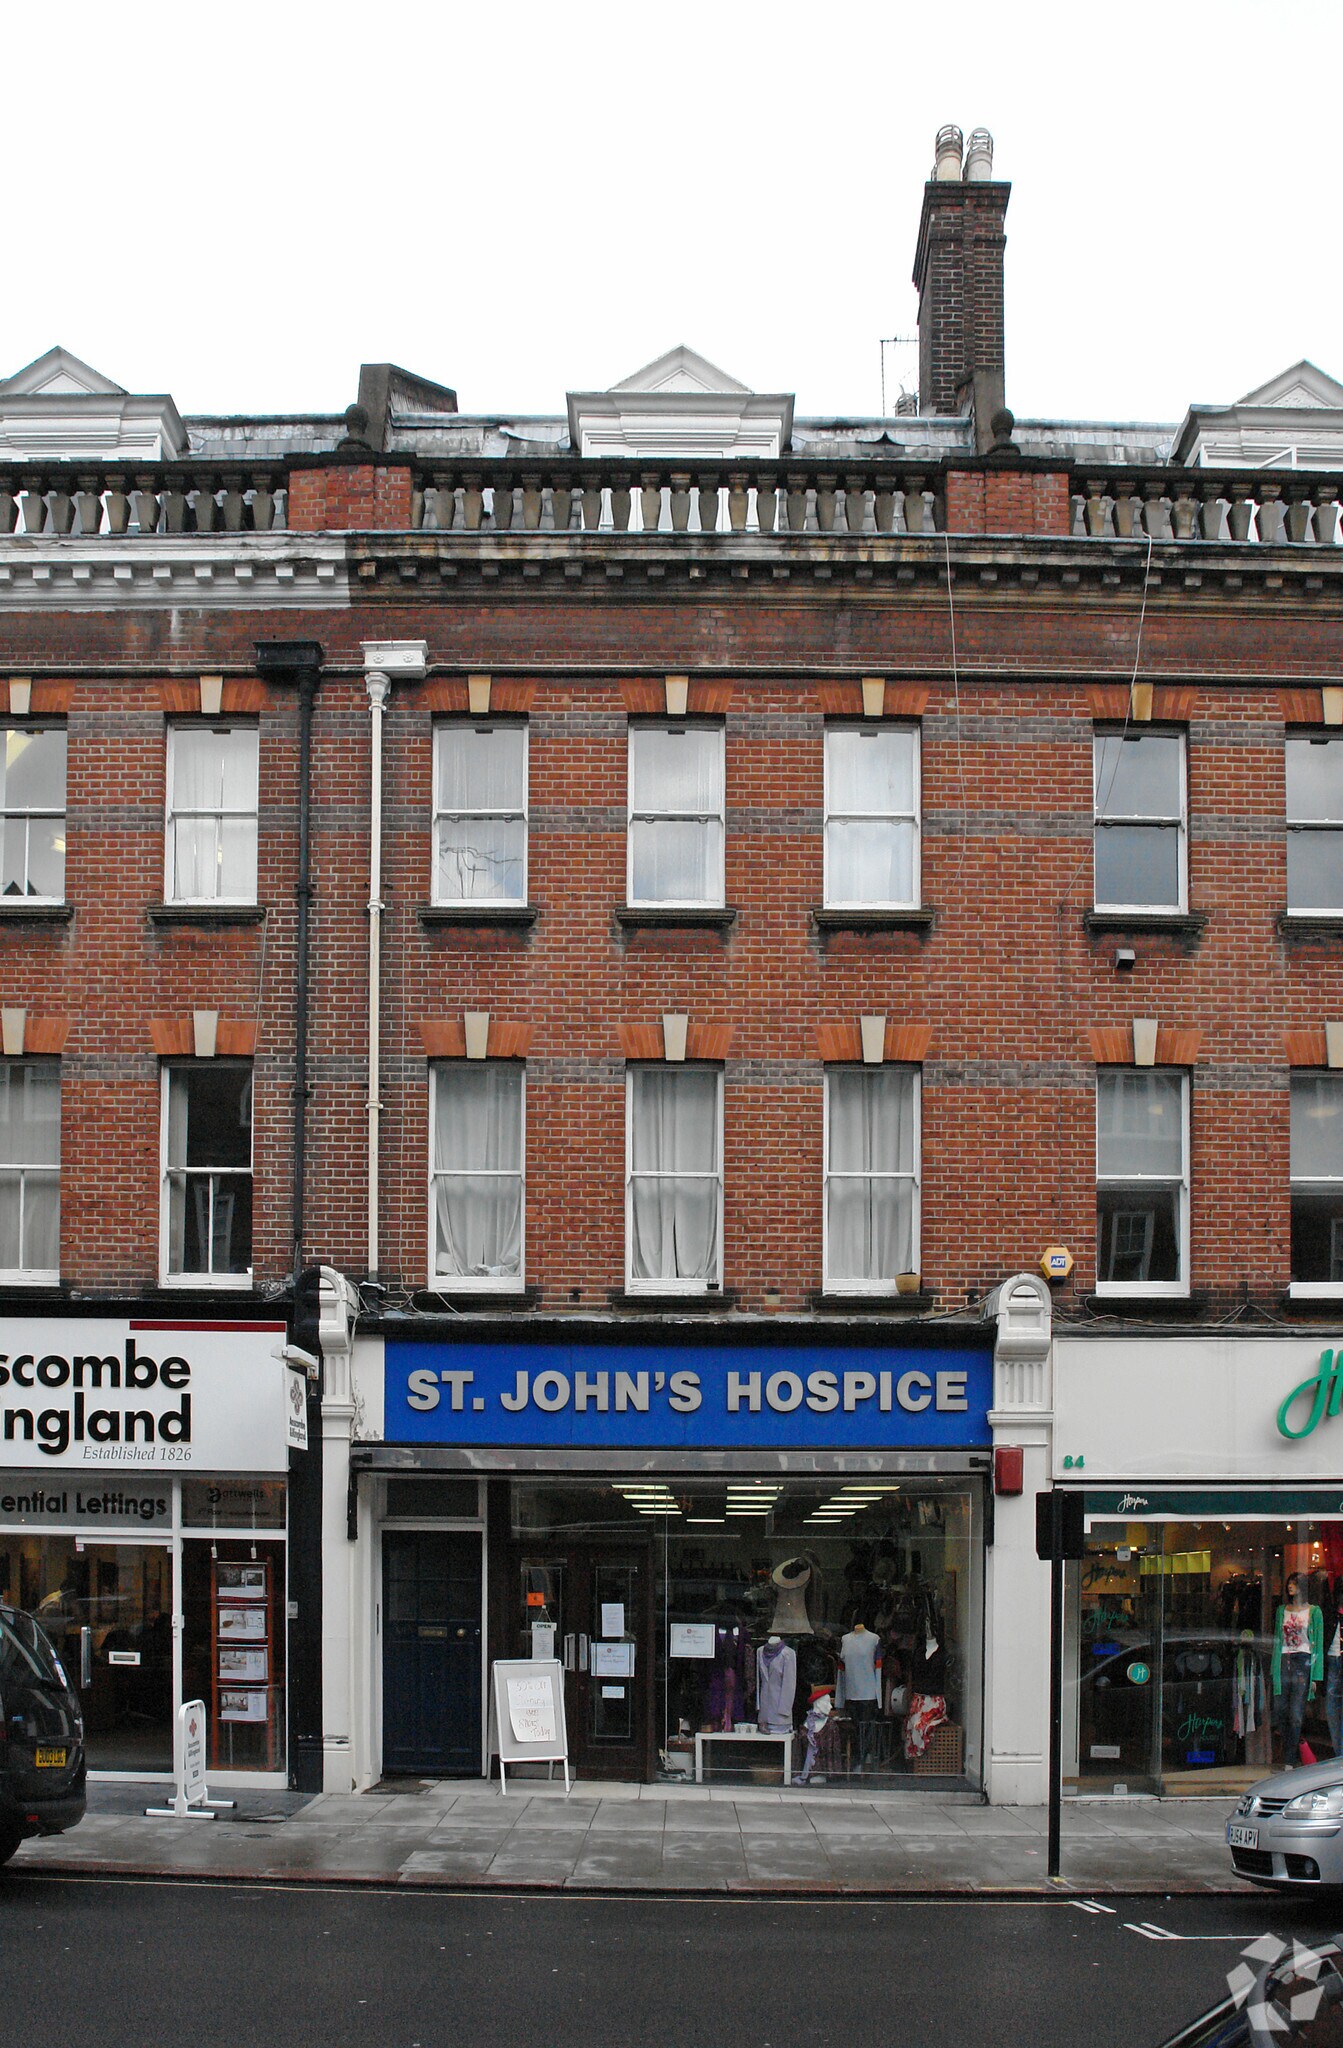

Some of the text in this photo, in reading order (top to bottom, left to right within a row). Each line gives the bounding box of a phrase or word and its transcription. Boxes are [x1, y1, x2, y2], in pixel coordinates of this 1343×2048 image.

[1050, 1257, 1066, 1266] ADT
[407, 1369, 968, 1412] ST. JOHN'S HOSPICE
[82, 1446, 192, 1461] Established 1826
[1063, 1455, 1085, 1469] 84
[76, 1492, 167, 1520] Lettings
